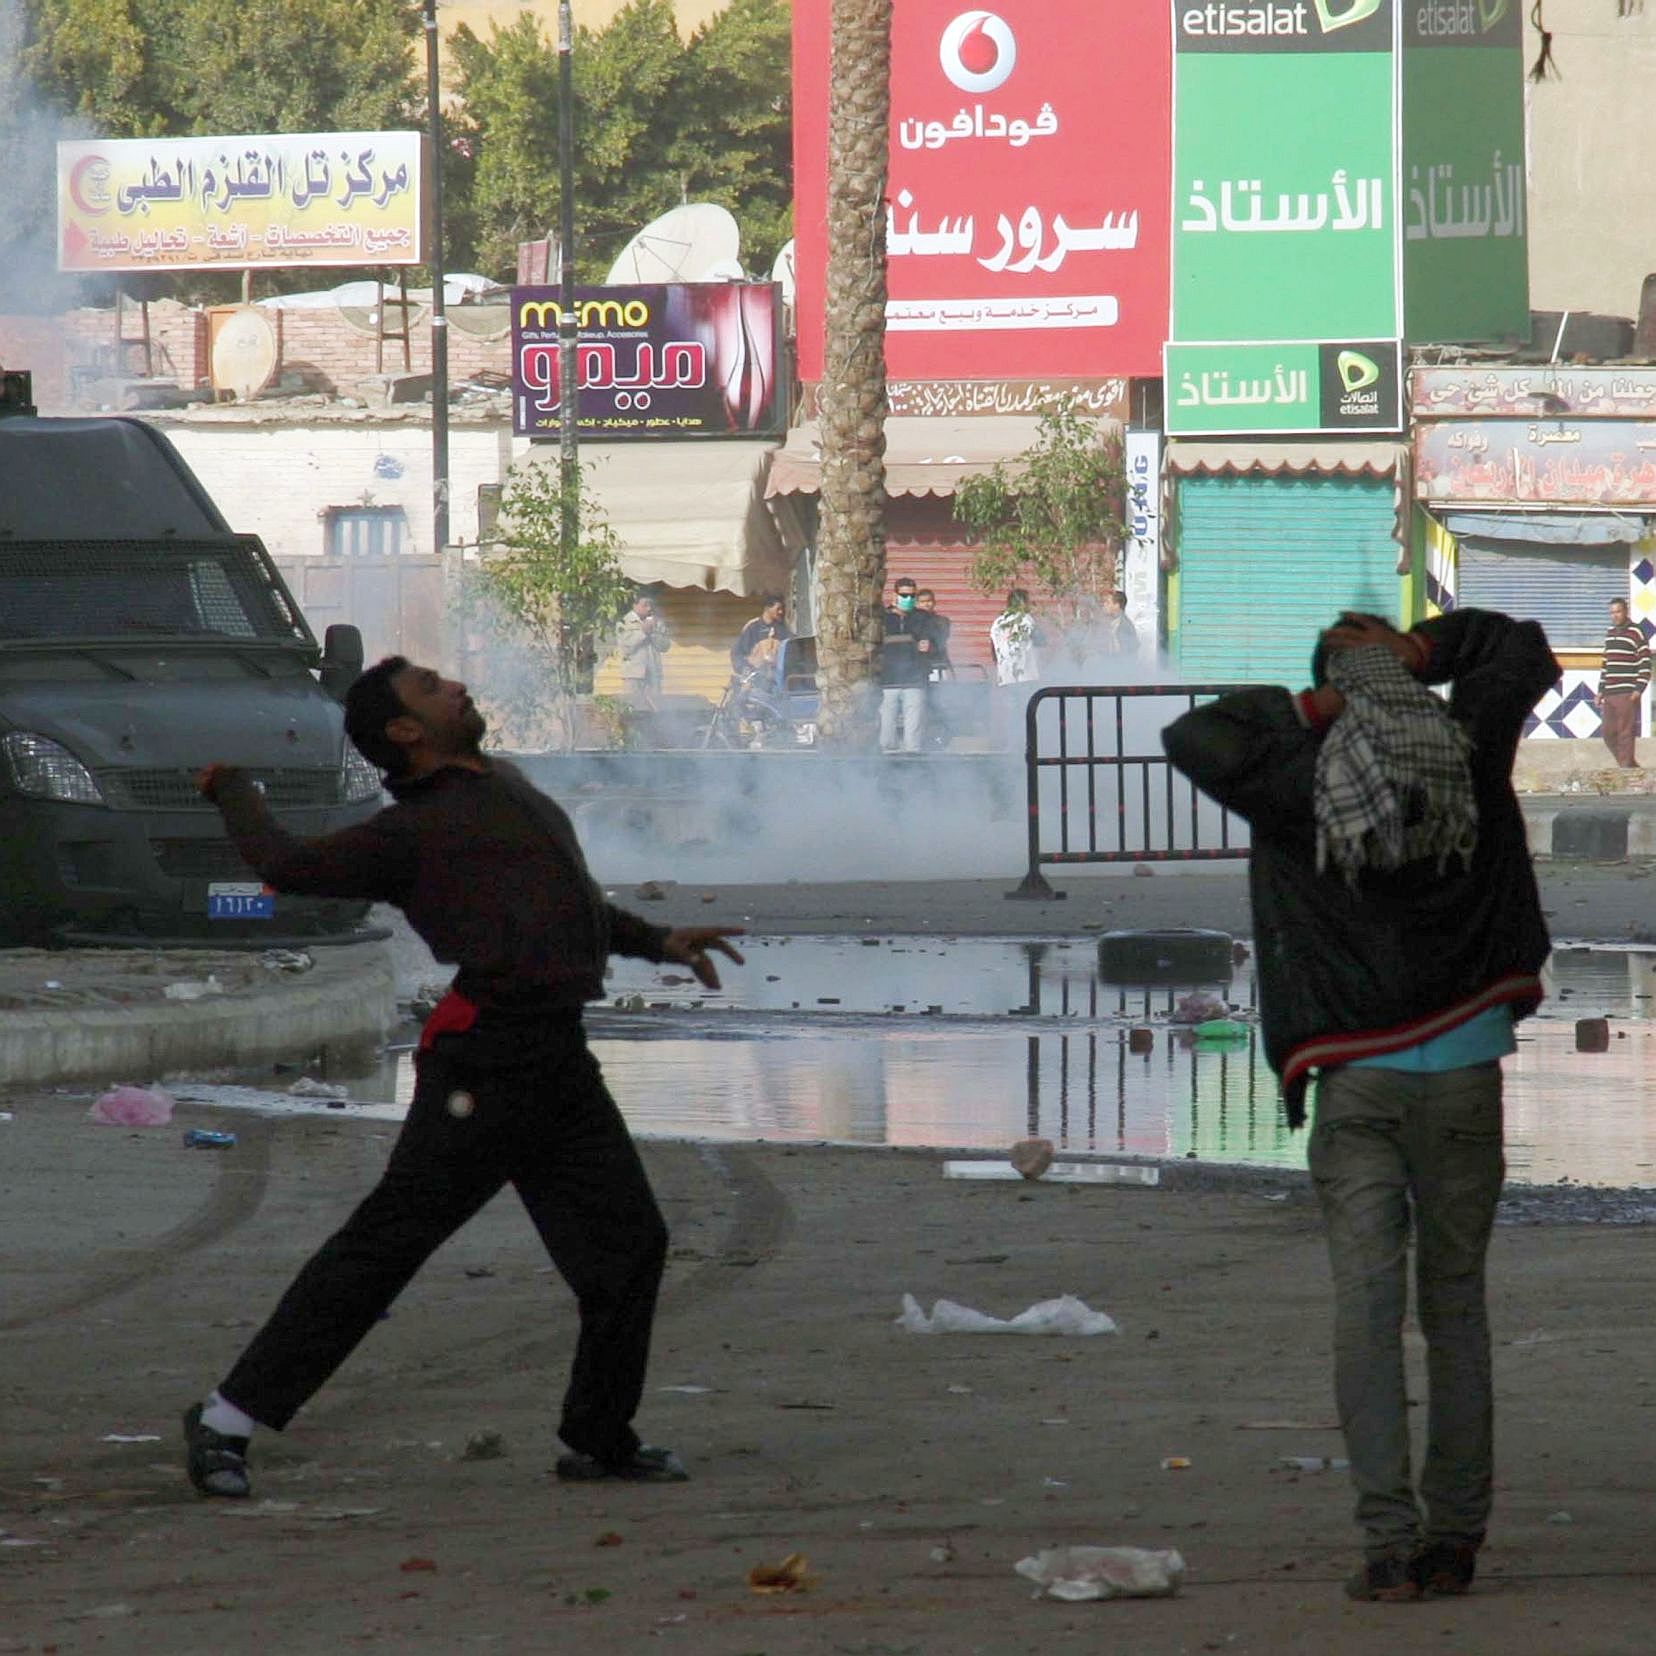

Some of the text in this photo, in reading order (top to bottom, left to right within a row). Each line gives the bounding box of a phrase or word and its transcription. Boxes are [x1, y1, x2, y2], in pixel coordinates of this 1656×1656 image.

[1182, 3, 1308, 36] etisalat
[1417, 0, 1476, 36] etisalat
[202, 150, 284, 213] القلزم
[292, 150, 330, 209] تل
[338, 150, 408, 208] مركز
[1182, 168, 1382, 232] الأستاذ
[1406, 150, 1523, 240] الأستاذ
[88, 230, 131, 257] طبية
[132, 228, 188, 256] تحاليل
[265, 227, 361, 251] التخصصات
[364, 225, 410, 254] جميع
[976, 205, 1138, 273] سرور
[938, 308, 983, 324] وبيع
[985, 306, 1040, 321] خدمة
[1043, 303, 1098, 321] مركز
[521, 341, 706, 411] ميمو
[1178, 364, 1307, 406] الأستاذ
[1504, 378, 1532, 400] كل
[1340, 391, 1377, 404] اتصالات
[1578, 380, 1605, 403] من
[1339, 402, 1379, 415] etisalat
[1527, 424, 1582, 447] معصرة
